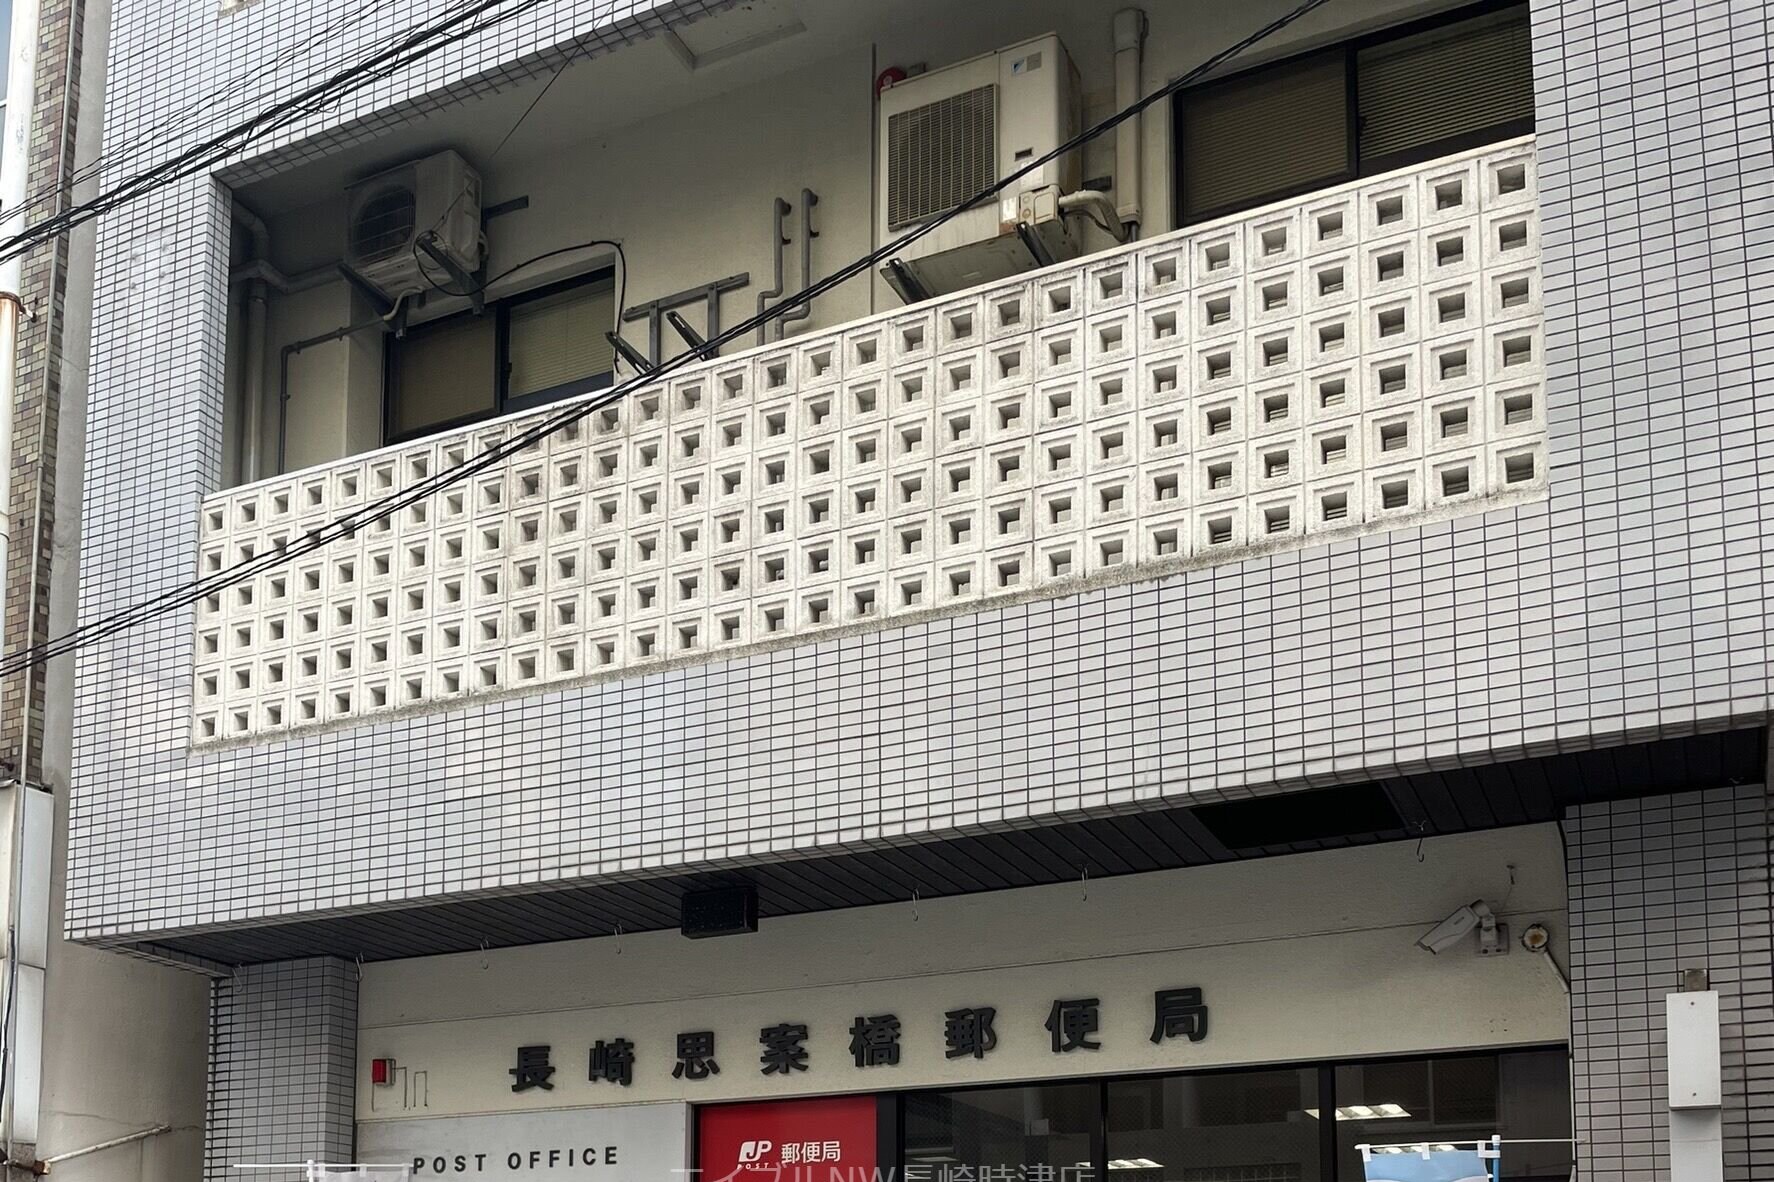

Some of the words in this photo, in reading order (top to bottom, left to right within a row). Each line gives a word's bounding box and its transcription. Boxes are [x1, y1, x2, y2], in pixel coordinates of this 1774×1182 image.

[508, 987, 1208, 1092] 長崎思案橋郵便局
[414, 1153, 487, 1175] POST
[507, 1145, 619, 1170] OFFICE
[781, 1141, 841, 1164] 郵便局
